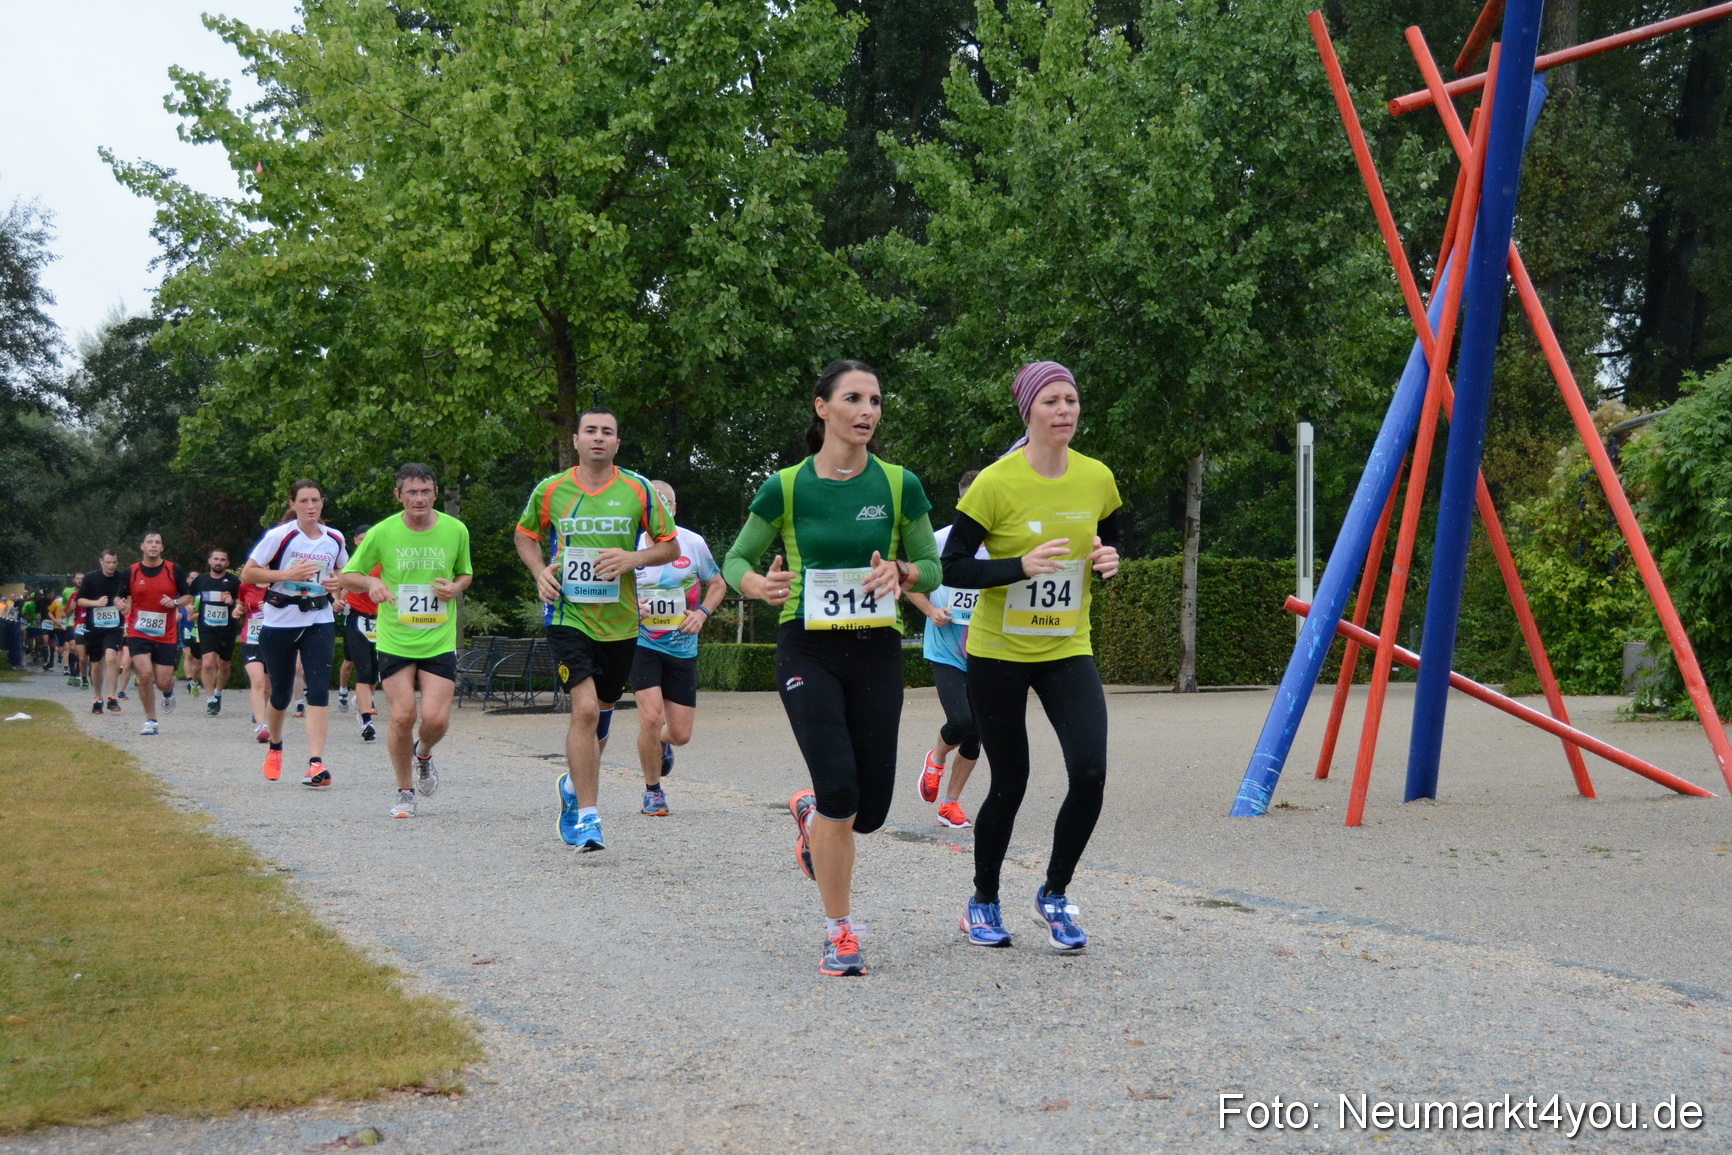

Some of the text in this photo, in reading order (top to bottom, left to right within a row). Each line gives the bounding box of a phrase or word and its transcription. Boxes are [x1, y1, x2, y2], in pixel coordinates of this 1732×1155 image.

[856, 504, 887, 518] AOK
[558, 517, 632, 535] BOCK
[291, 551, 331, 562] SPARKASSEN
[395, 547, 446, 558] NOVINA
[397, 560, 446, 570] HOTELS
[574, 586, 607, 596] Sleiman
[1026, 580, 1072, 608] 134
[409, 595, 439, 612] 214
[648, 599, 675, 615] 101
[823, 588, 878, 617] 314
[96, 611, 117, 620] 2851
[207, 609, 227, 619] 2478
[139, 617, 164, 629] 2882
[411, 616, 437, 624] Thomas
[652, 617, 671, 625] Claus
[1030, 614, 1060, 626] Anika
